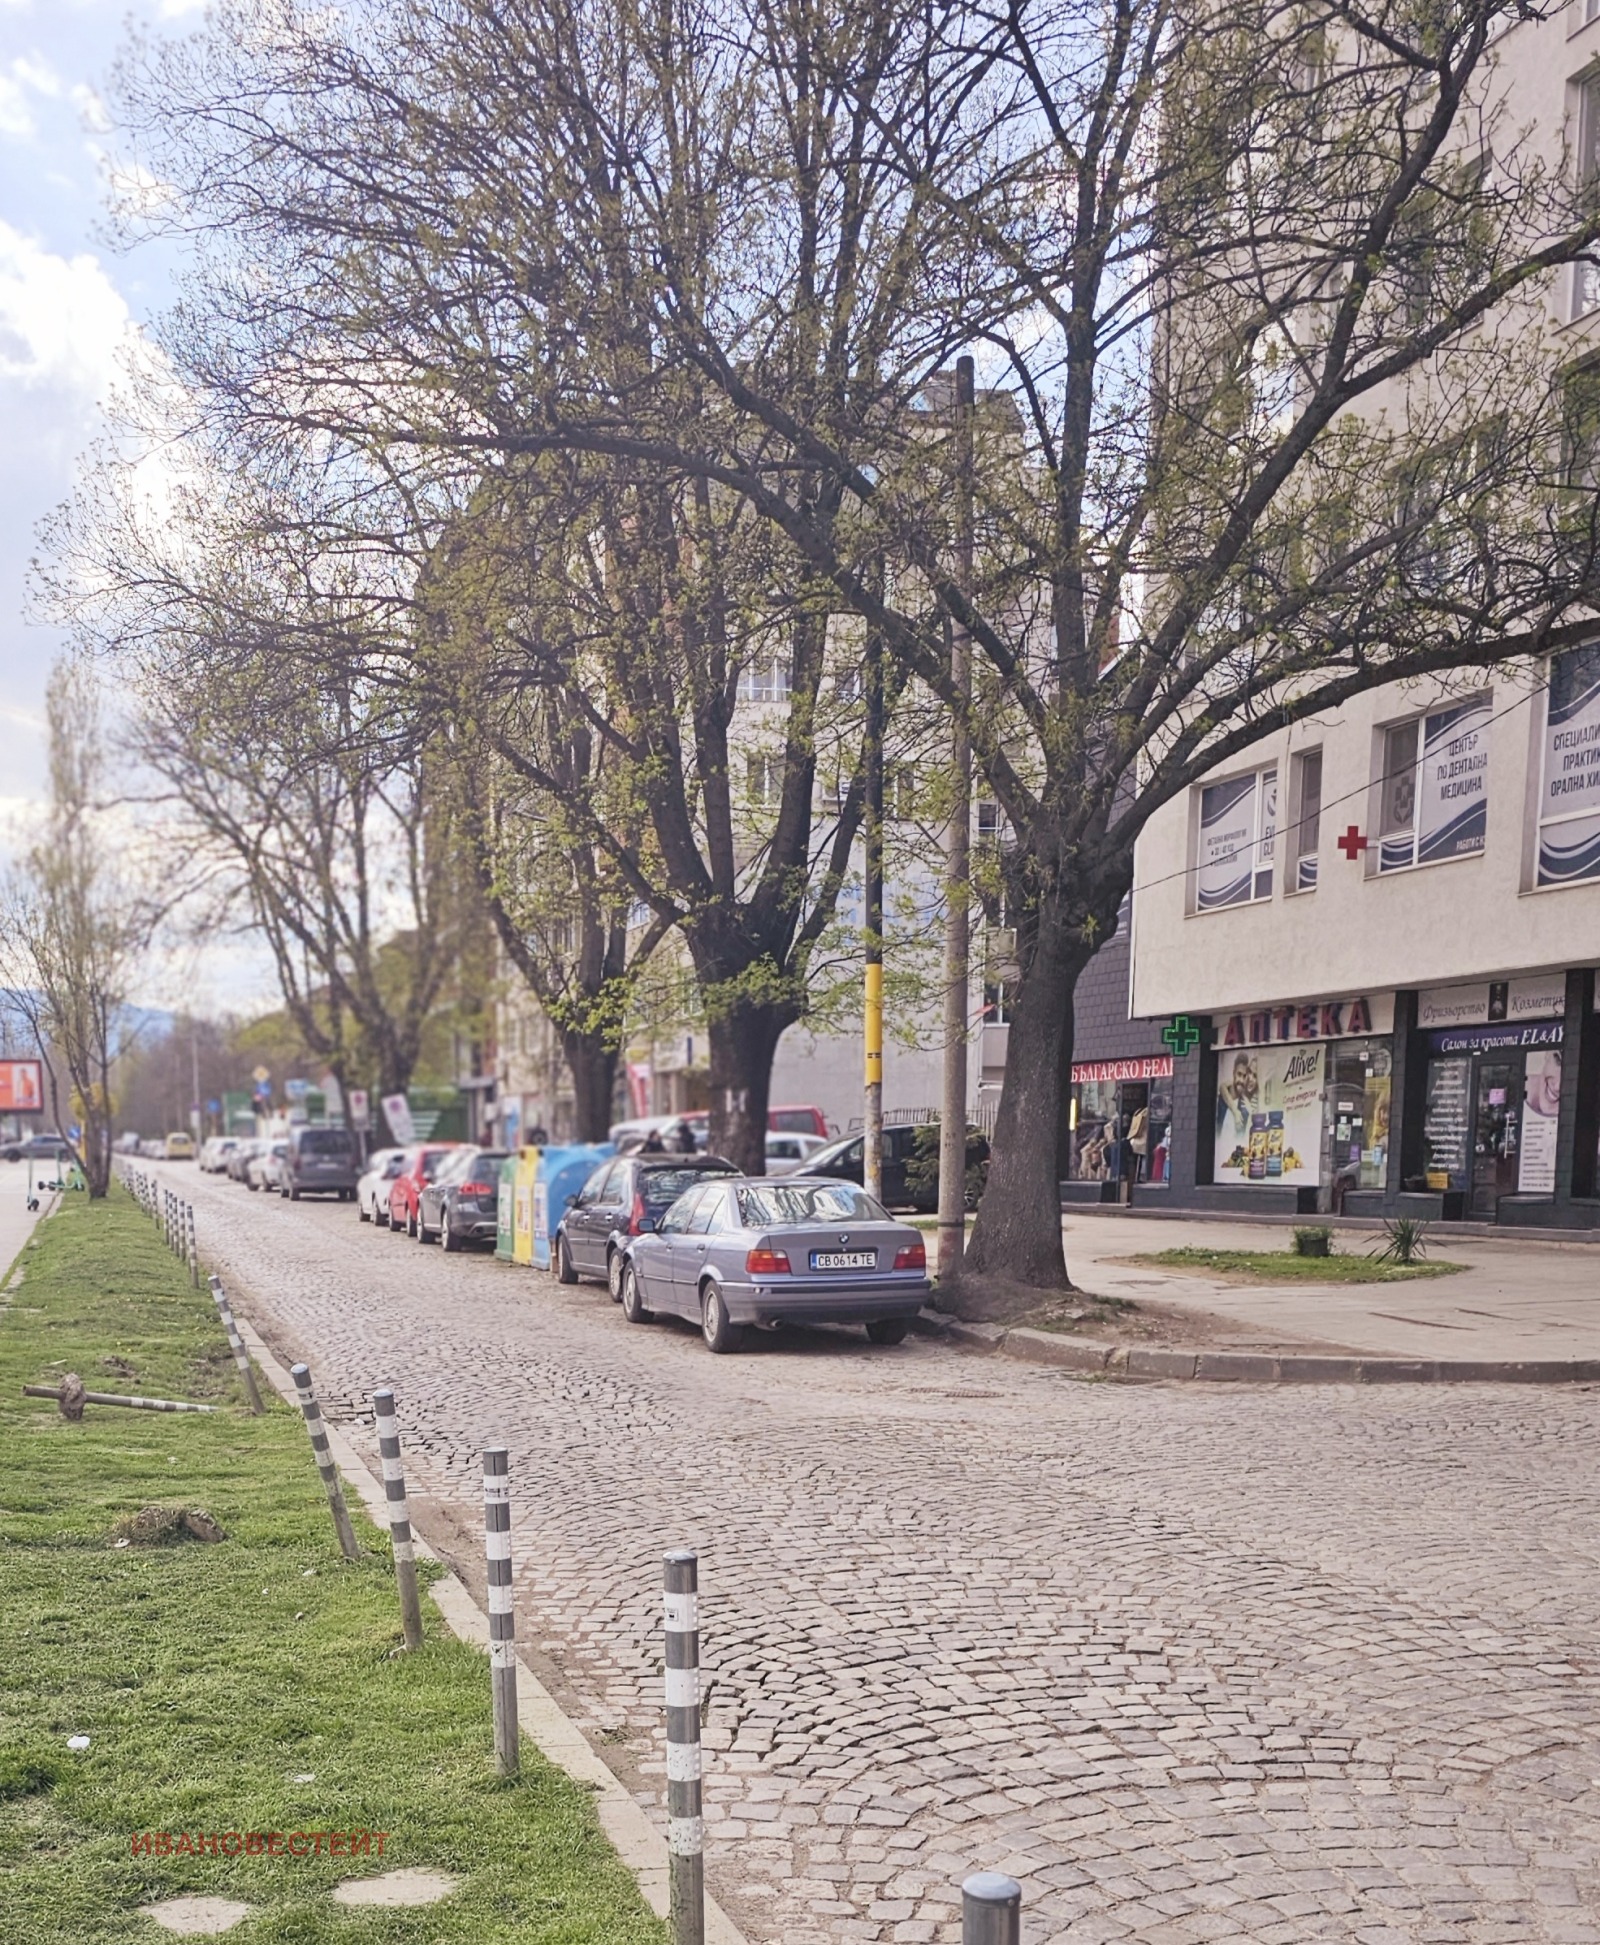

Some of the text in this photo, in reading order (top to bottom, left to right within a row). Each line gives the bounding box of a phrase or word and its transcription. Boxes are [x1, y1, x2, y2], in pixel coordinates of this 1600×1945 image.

[1449, 734, 1478, 757] ЦЕНТЪР
[1437, 752, 1488, 780] ПО ДЕНТАЛНА
[1440, 775, 1482, 800] МЕДИЦИНА
[1551, 773, 1585, 797] ОРАЛНА
[1224, 997, 1372, 1046] АПТЕКА
[1441, 1037, 1467, 1052] Салон
[1469, 1037, 1480, 1049] за
[1481, 1035, 1518, 1052] красота
[1071, 1060, 1140, 1083] БЪЛГАРСКО
[1283, 1049, 1320, 1083] Alive!
[818, 1253, 873, 1267] CB 0614 TE
